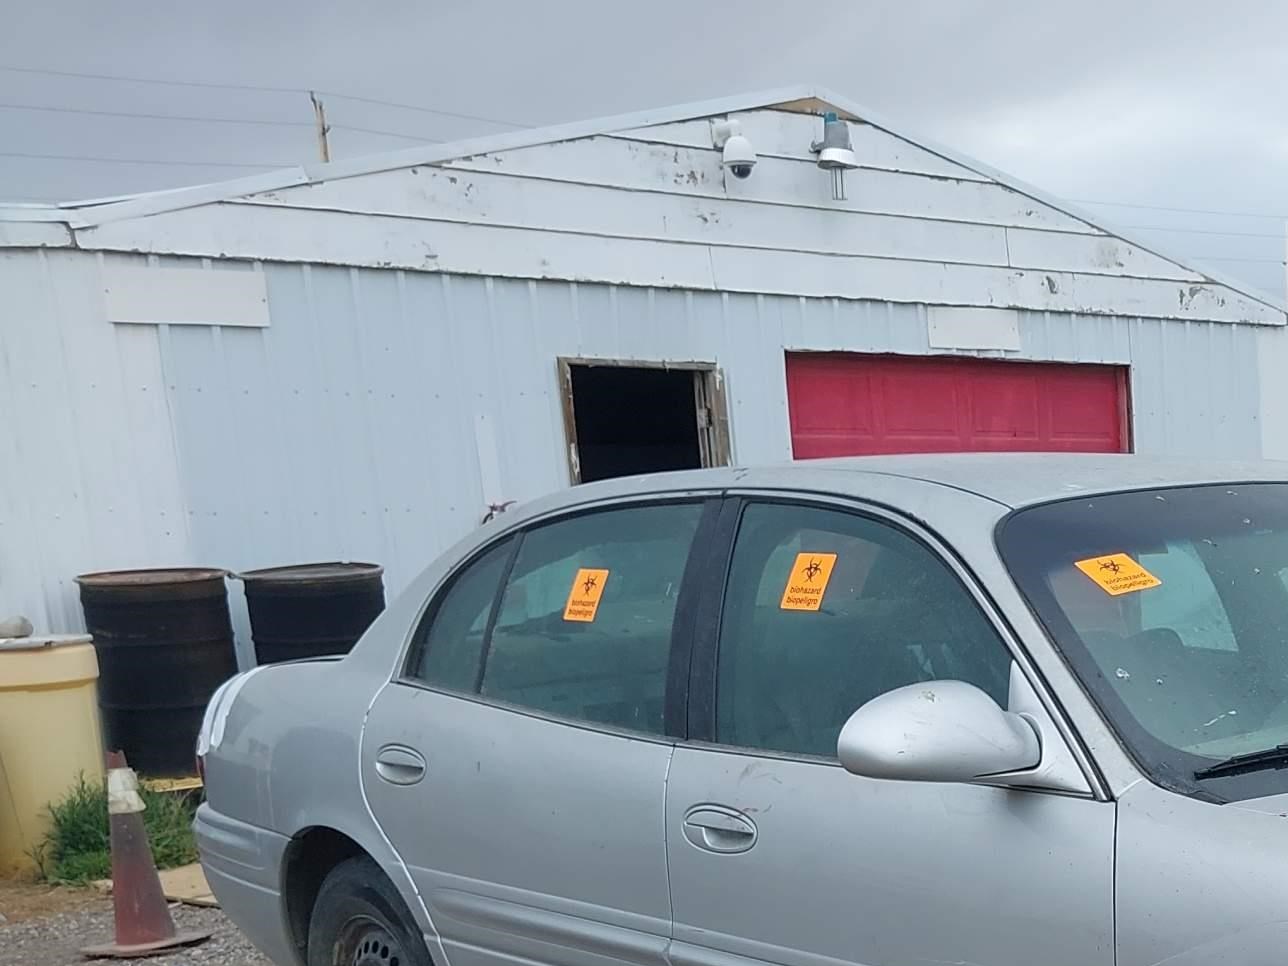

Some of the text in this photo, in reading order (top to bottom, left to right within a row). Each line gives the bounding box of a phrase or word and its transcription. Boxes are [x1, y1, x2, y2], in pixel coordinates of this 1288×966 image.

[1103, 572, 1146, 585] biohazard
[790, 585, 822, 595] biohazard
[786, 596, 818, 606] biopeligro
